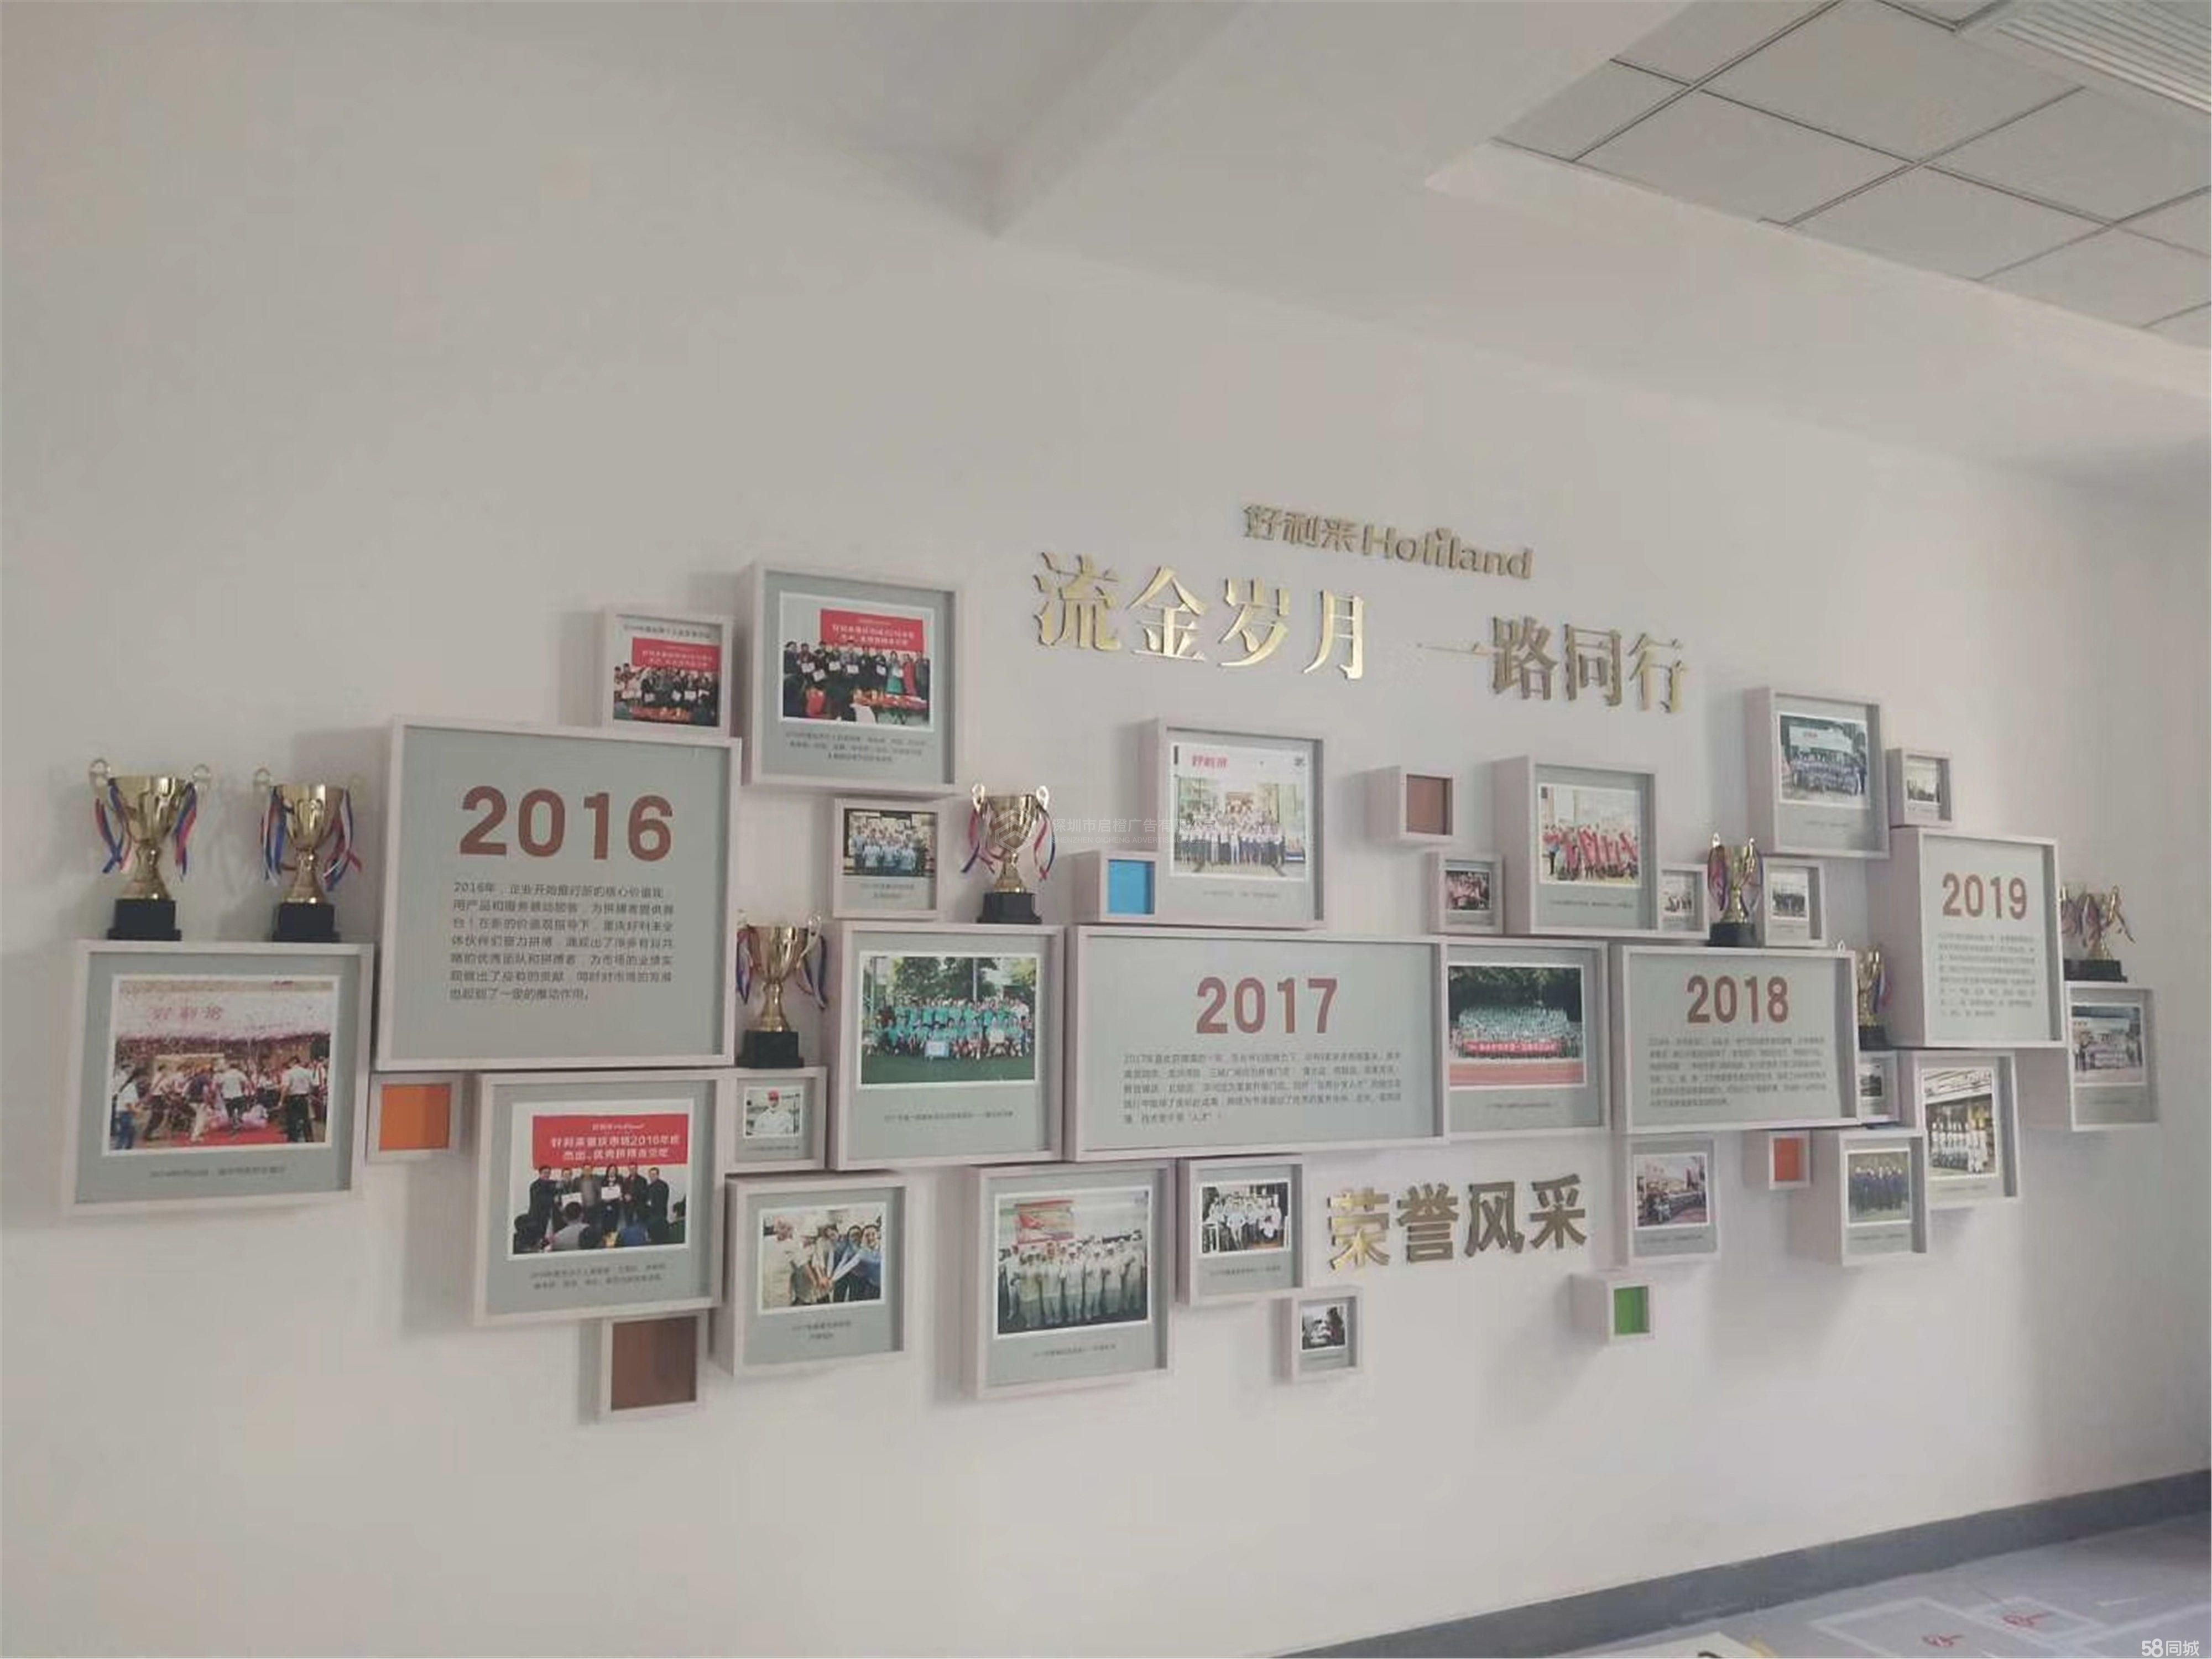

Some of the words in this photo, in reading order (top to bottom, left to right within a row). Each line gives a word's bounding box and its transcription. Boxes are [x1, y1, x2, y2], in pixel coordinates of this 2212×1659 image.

[1244, 504, 1358, 552] 好利来
[1363, 524, 1535, 579] Holiland
[1034, 551, 1368, 679] 流金岁月
[1417, 613, 1689, 714] 一路同行
[460, 785, 674, 862] 2016
[1942, 872, 2028, 921] 2019
[1196, 976, 1338, 1035] 2017
[1686, 975, 1790, 1024] 2018
[1326, 1173, 1587, 1271] 荣誉风采
